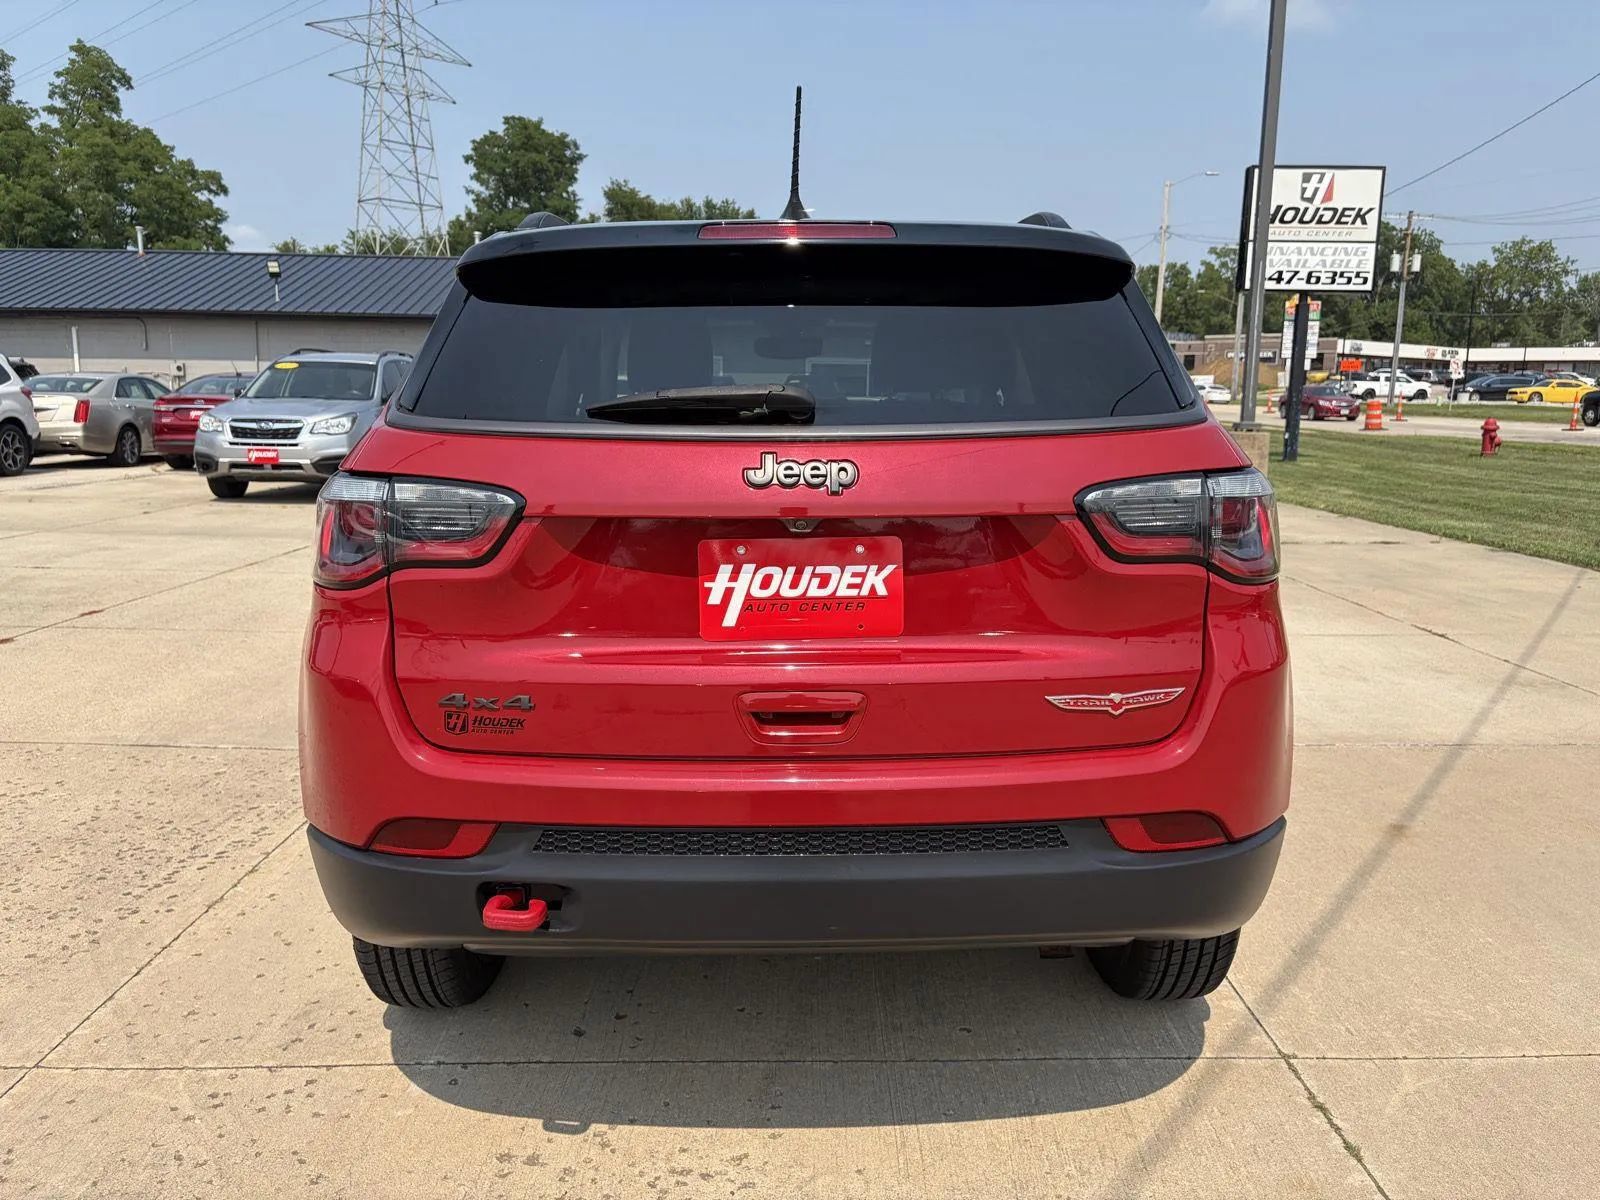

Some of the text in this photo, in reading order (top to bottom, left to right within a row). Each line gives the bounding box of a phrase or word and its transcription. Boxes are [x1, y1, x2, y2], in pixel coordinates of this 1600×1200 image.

[1267, 246, 1369, 257] INANCING
[1268, 258, 1371, 269] VAILABLE
[1265, 270, 1371, 286] 47-6355
[742, 451, 859, 495] Jeep
[704, 563, 898, 627] HOUDEK
[744, 602, 866, 613] AUTO CENTER
[472, 715, 526, 728] HOUDEK
